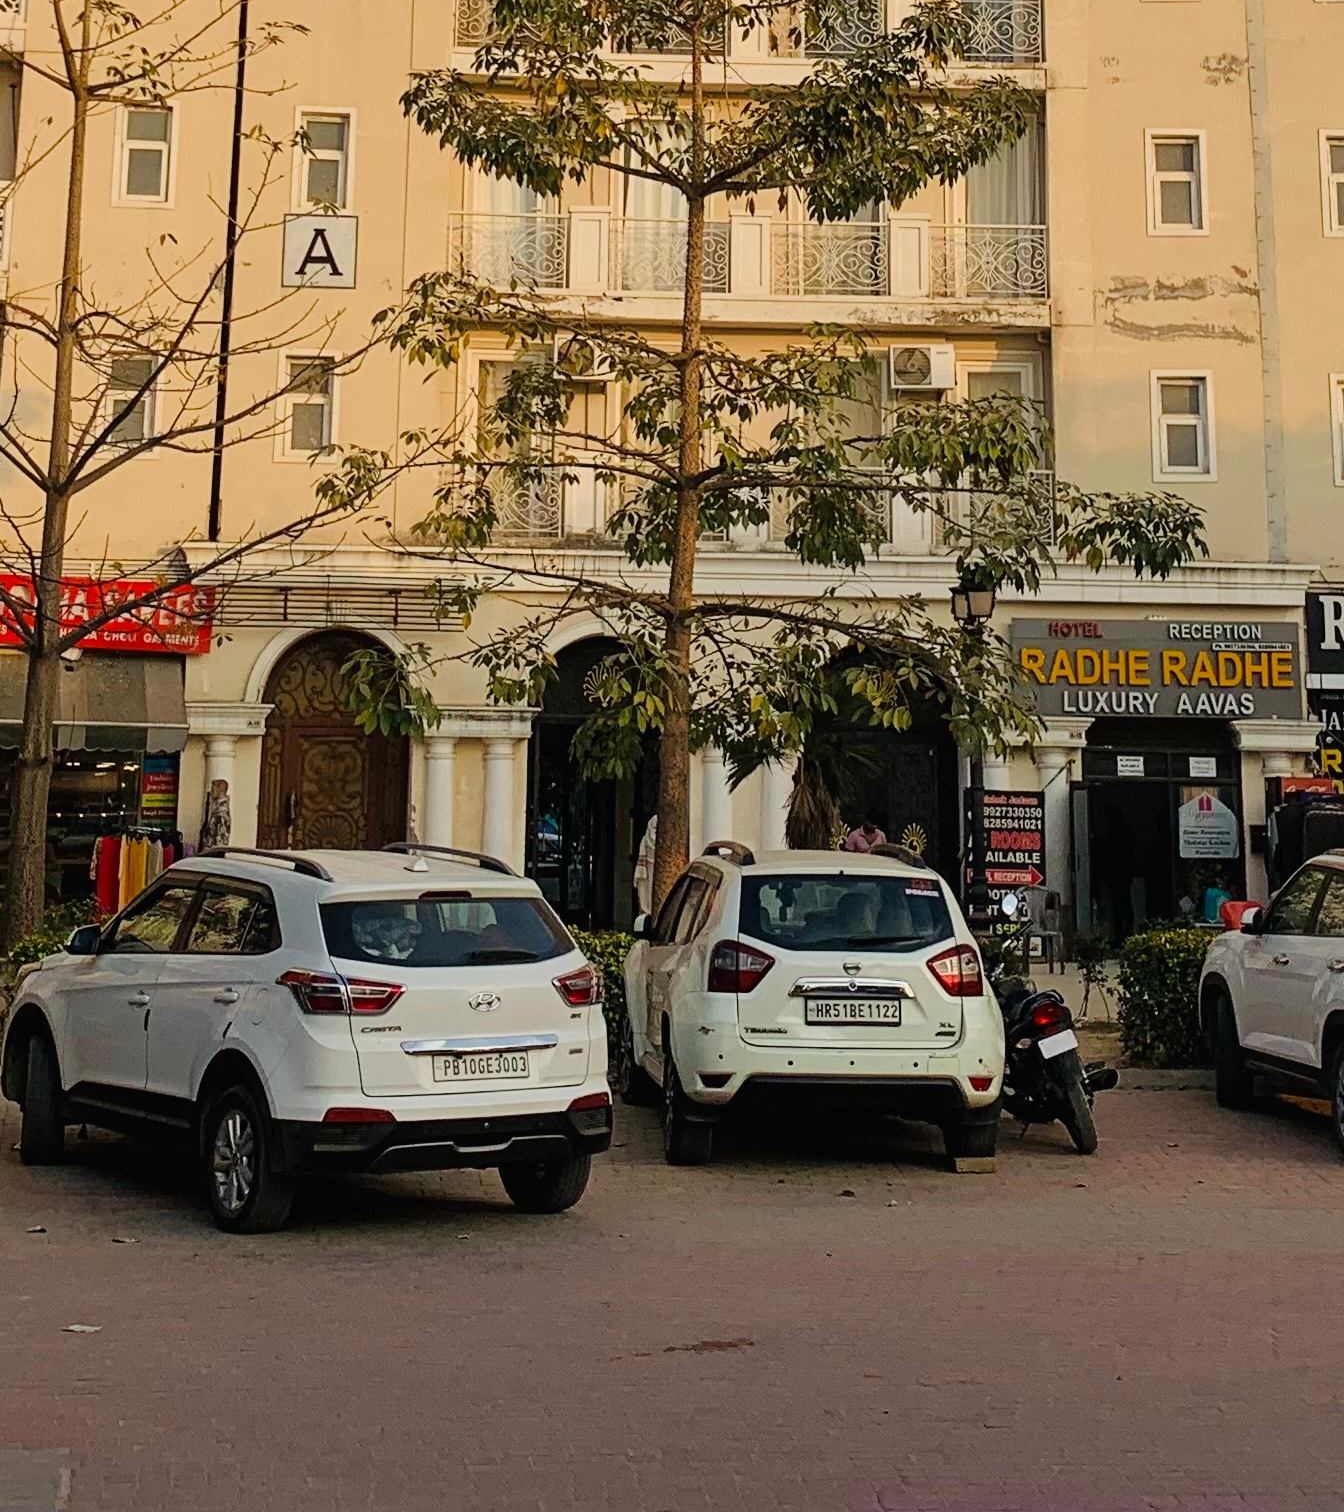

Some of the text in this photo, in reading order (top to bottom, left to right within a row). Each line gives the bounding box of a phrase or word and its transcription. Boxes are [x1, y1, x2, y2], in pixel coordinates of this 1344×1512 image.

[294, 228, 344, 276] A
[1048, 622, 1262, 640] HOTEL RECEPTION
[1020, 648, 1295, 688] RADHE RADHE
[1062, 690, 1255, 716] LUXURY AAVAS
[983, 818, 1042, 829] 8285941021
[991, 831, 1042, 850] ROOMS
[994, 872, 1033, 882] RECEPTION
[815, 1003, 898, 1019] HR51BE1122
[444, 1056, 527, 1077] PB10GE3003
